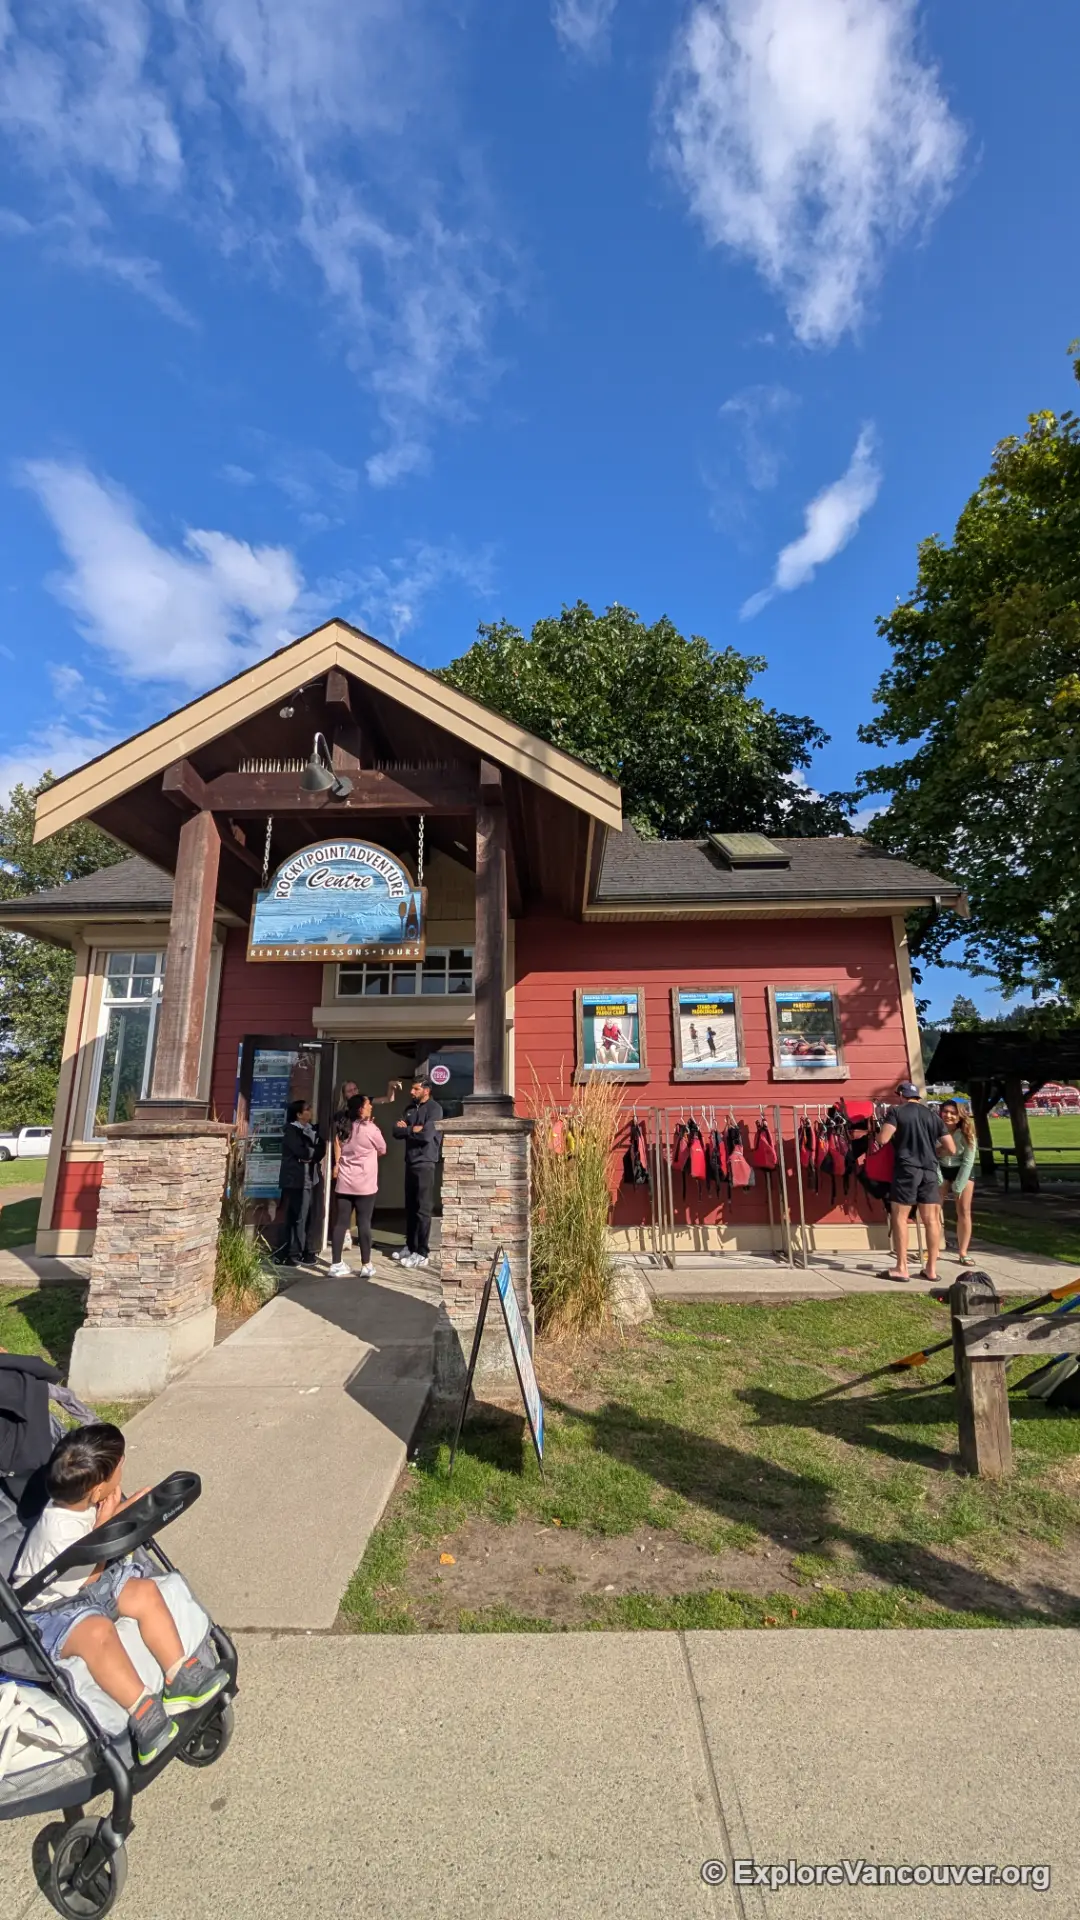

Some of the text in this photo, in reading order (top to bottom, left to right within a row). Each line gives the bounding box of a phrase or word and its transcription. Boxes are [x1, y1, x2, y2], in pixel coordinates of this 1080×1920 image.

[276, 846, 404, 898] ROCKY POINT ADVENTURE
[308, 867, 372, 889] Centre
[250, 948, 420, 957] RENTALS LESSONS TOURS
